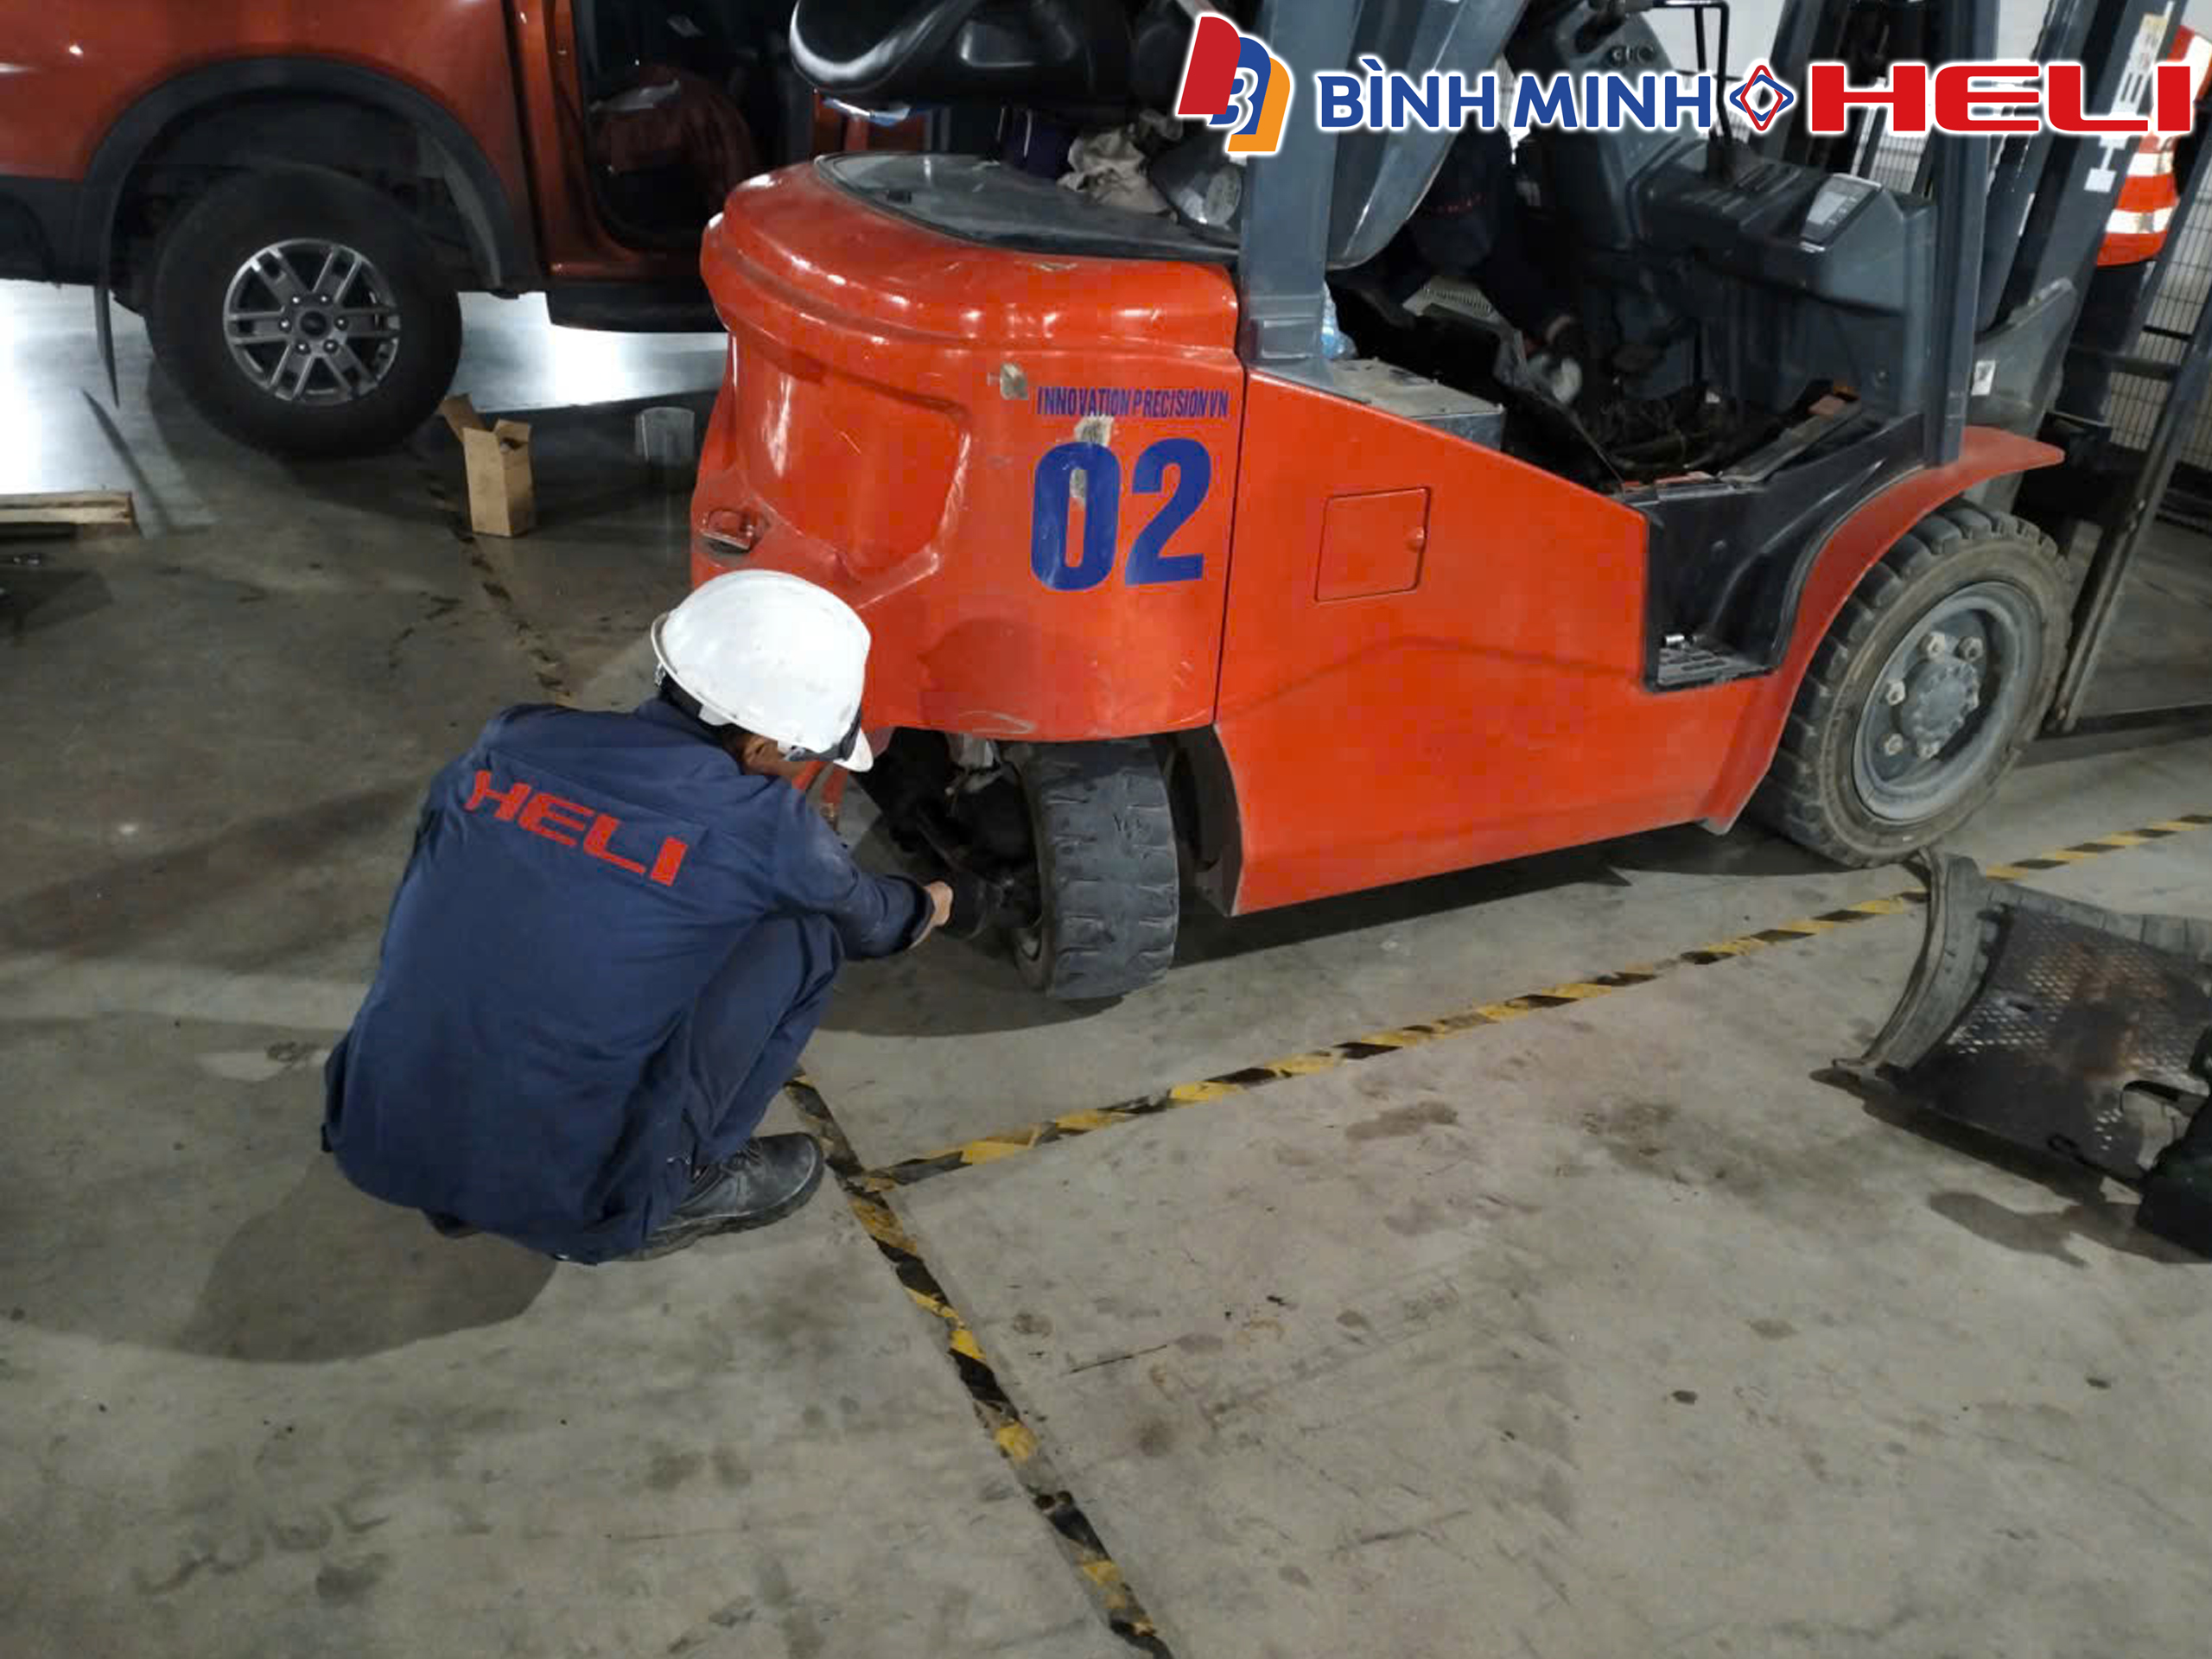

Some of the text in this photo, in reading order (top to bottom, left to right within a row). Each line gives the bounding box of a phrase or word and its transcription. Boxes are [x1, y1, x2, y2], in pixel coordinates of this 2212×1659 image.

[1037, 386, 1130, 416] INNOVATION
[1031, 437, 1211, 591] 02
[464, 769, 689, 887] HELI
